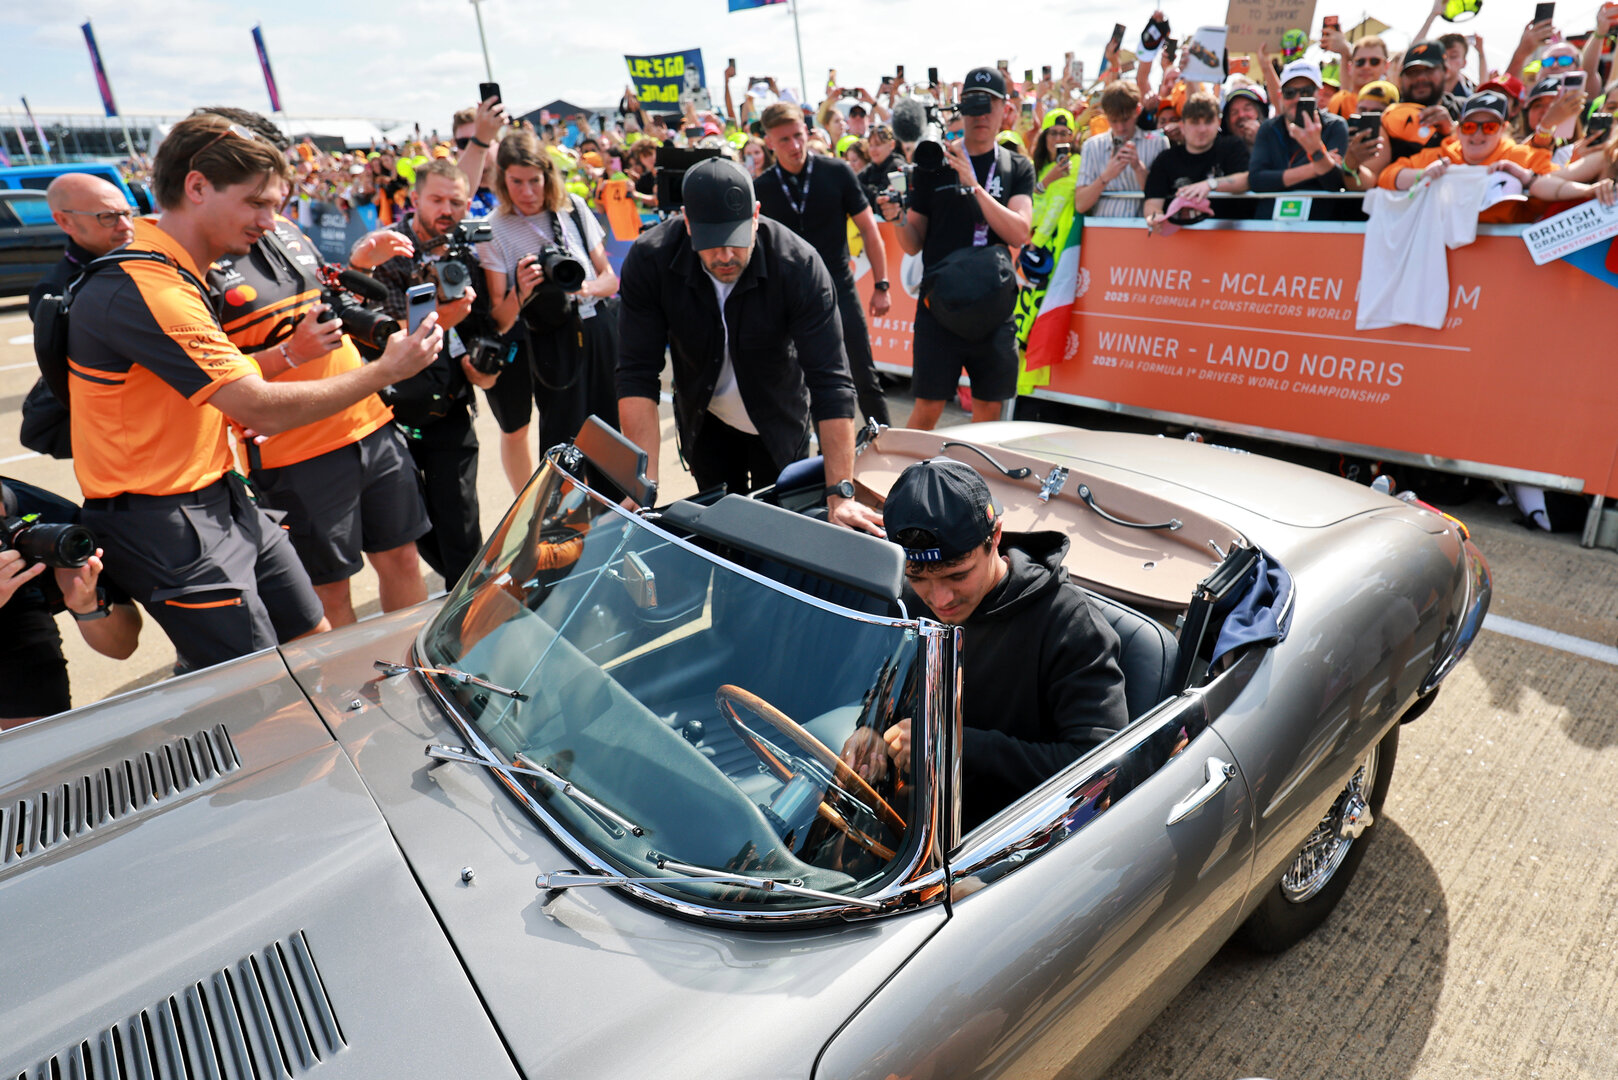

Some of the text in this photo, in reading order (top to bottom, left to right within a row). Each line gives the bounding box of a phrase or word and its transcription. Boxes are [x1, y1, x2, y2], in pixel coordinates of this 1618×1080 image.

[1528, 208, 1595, 242] BRITISH
[1534, 217, 1604, 249] GRAND PRIX
[1539, 232, 1598, 260] SILVERSTONE
[1110, 266, 1192, 290] WINNER
[1220, 272, 1343, 301] MCLAREN
[1104, 291, 1129, 302] 2025
[1131, 293, 1147, 304] FIA
[1149, 294, 1197, 308] FORMULA
[1212, 299, 1302, 317] CONSTRUCTORS
[1306, 305, 1352, 321] WORLD
[1098, 331, 1179, 359] WINNER
[1206, 343, 1289, 372] LANDO
[1299, 353, 1405, 387] NORRIS
[1092, 355, 1117, 367] 2025
[1119, 359, 1134, 369] FIA
[1137, 361, 1183, 377] FORMULA
[1198, 369, 1244, 385] DRIVERS
[1247, 375, 1289, 391] WORLD
[1292, 381, 1390, 404] CHAMPIONSHIP
